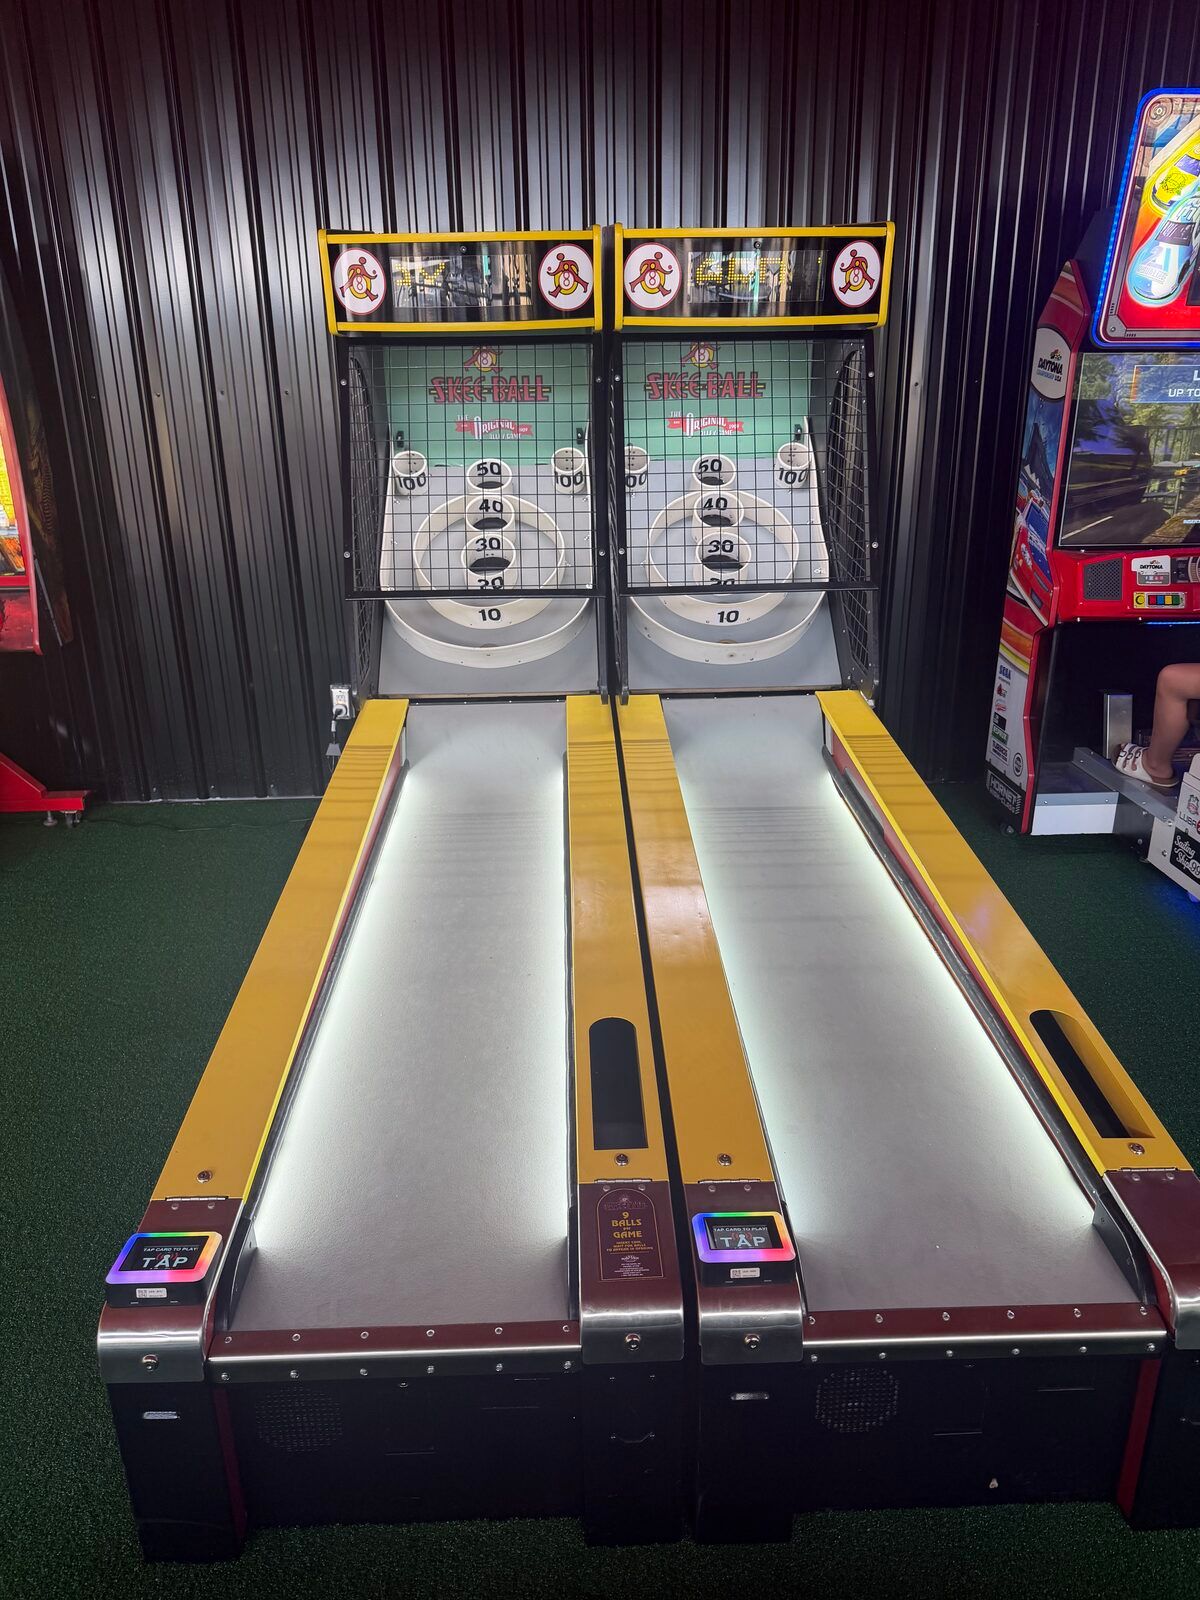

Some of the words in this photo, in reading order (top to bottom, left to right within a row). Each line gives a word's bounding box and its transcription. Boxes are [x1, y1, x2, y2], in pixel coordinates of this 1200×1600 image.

[1168, 389, 1184, 397] UP
[477, 462, 502, 477] 50
[698, 459, 722, 475] 50
[779, 468, 809, 484] 100
[478, 499, 503, 513] 40
[703, 497, 728, 511] 40
[475, 537, 500, 552] 30
[708, 539, 734, 553] 30
[478, 608, 502, 621] 10
[717, 610, 740, 623] 10
[622, 1211, 630, 1219] 9
[611, 1219, 642, 1227] BALLS
[613, 1231, 643, 1239] GAME
[720, 1234, 766, 1248] TAP
[142, 1255, 188, 1268] TAP
